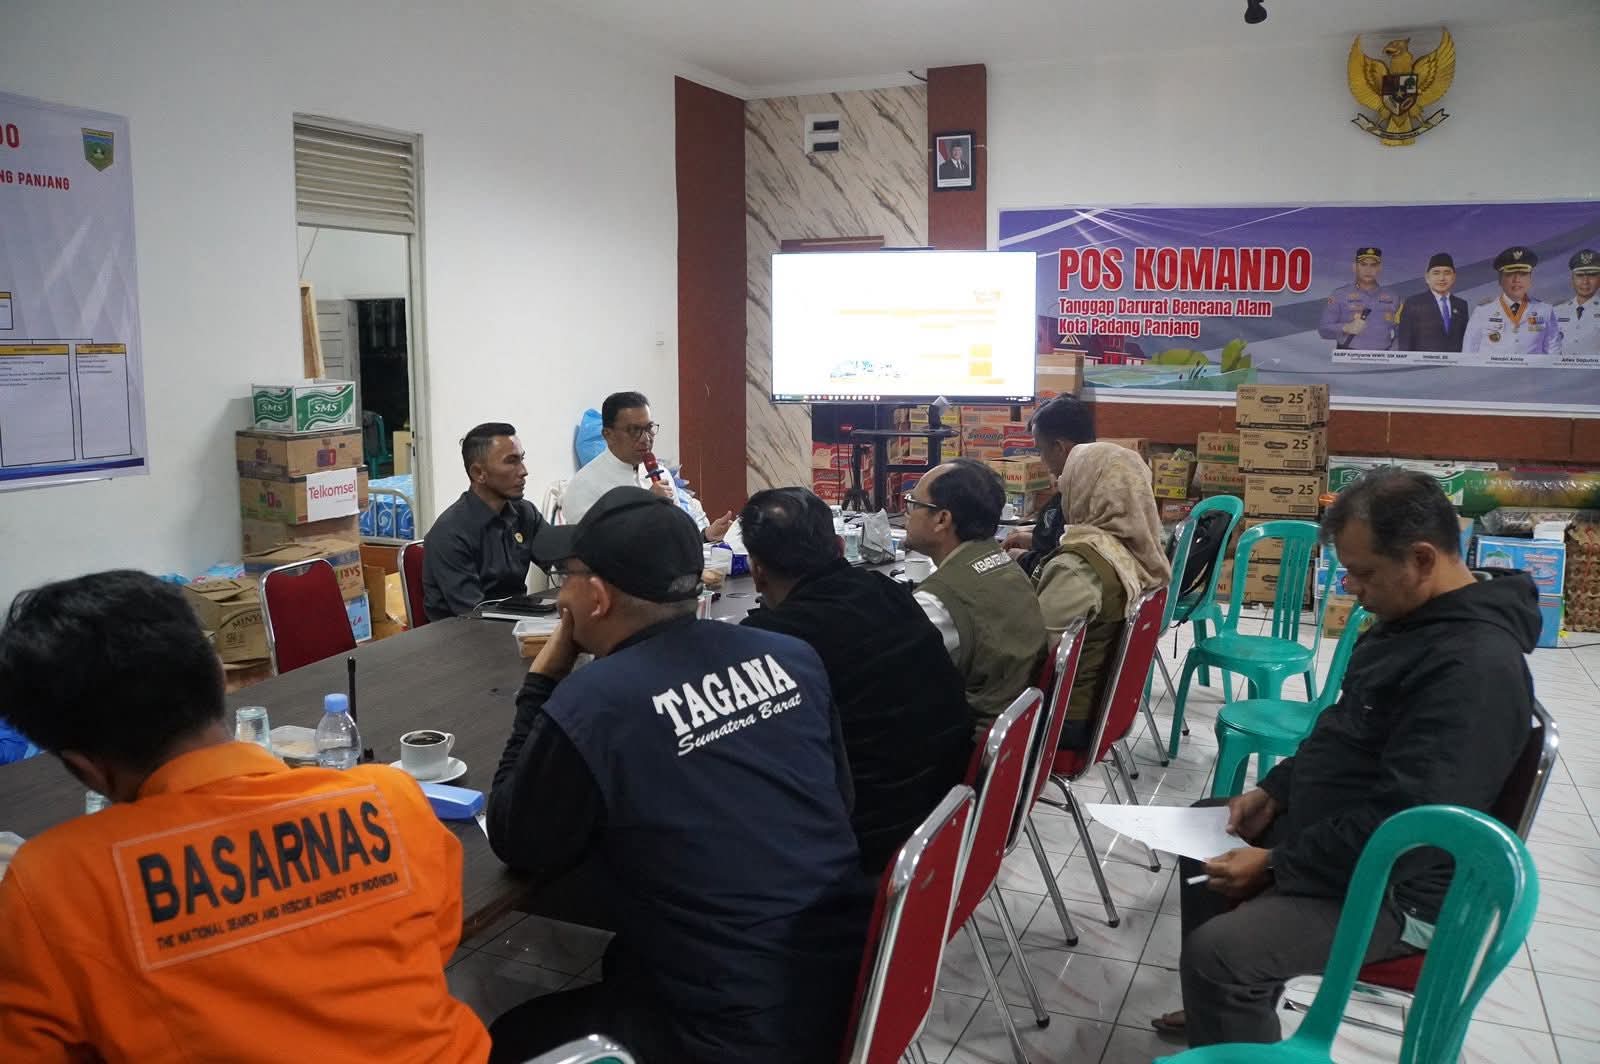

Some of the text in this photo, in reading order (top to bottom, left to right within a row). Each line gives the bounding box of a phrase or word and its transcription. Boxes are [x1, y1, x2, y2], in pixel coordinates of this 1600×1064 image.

[18, 172, 70, 190] PANJANG
[1058, 247, 1312, 293] POS KOMANDO
[1058, 298, 1272, 317] Tanggap Darurat Bencana Alam
[1058, 317, 1200, 338] Kota Padang Panjang
[262, 403, 283, 412] SMS
[313, 402, 338, 413] SMS
[1287, 392, 1304, 404] 25
[1292, 439, 1309, 450] 25
[308, 479, 356, 500] Telkomsel
[1298, 484, 1314, 495] 25
[652, 653, 798, 737] TAGANA
[677, 693, 802, 757] Sumatera Barat
[137, 801, 391, 924] BASARNAS
[157, 872, 398, 950] THE NATIONAL SEARCH AND RESCUE AGENCY OF INDONESIA
